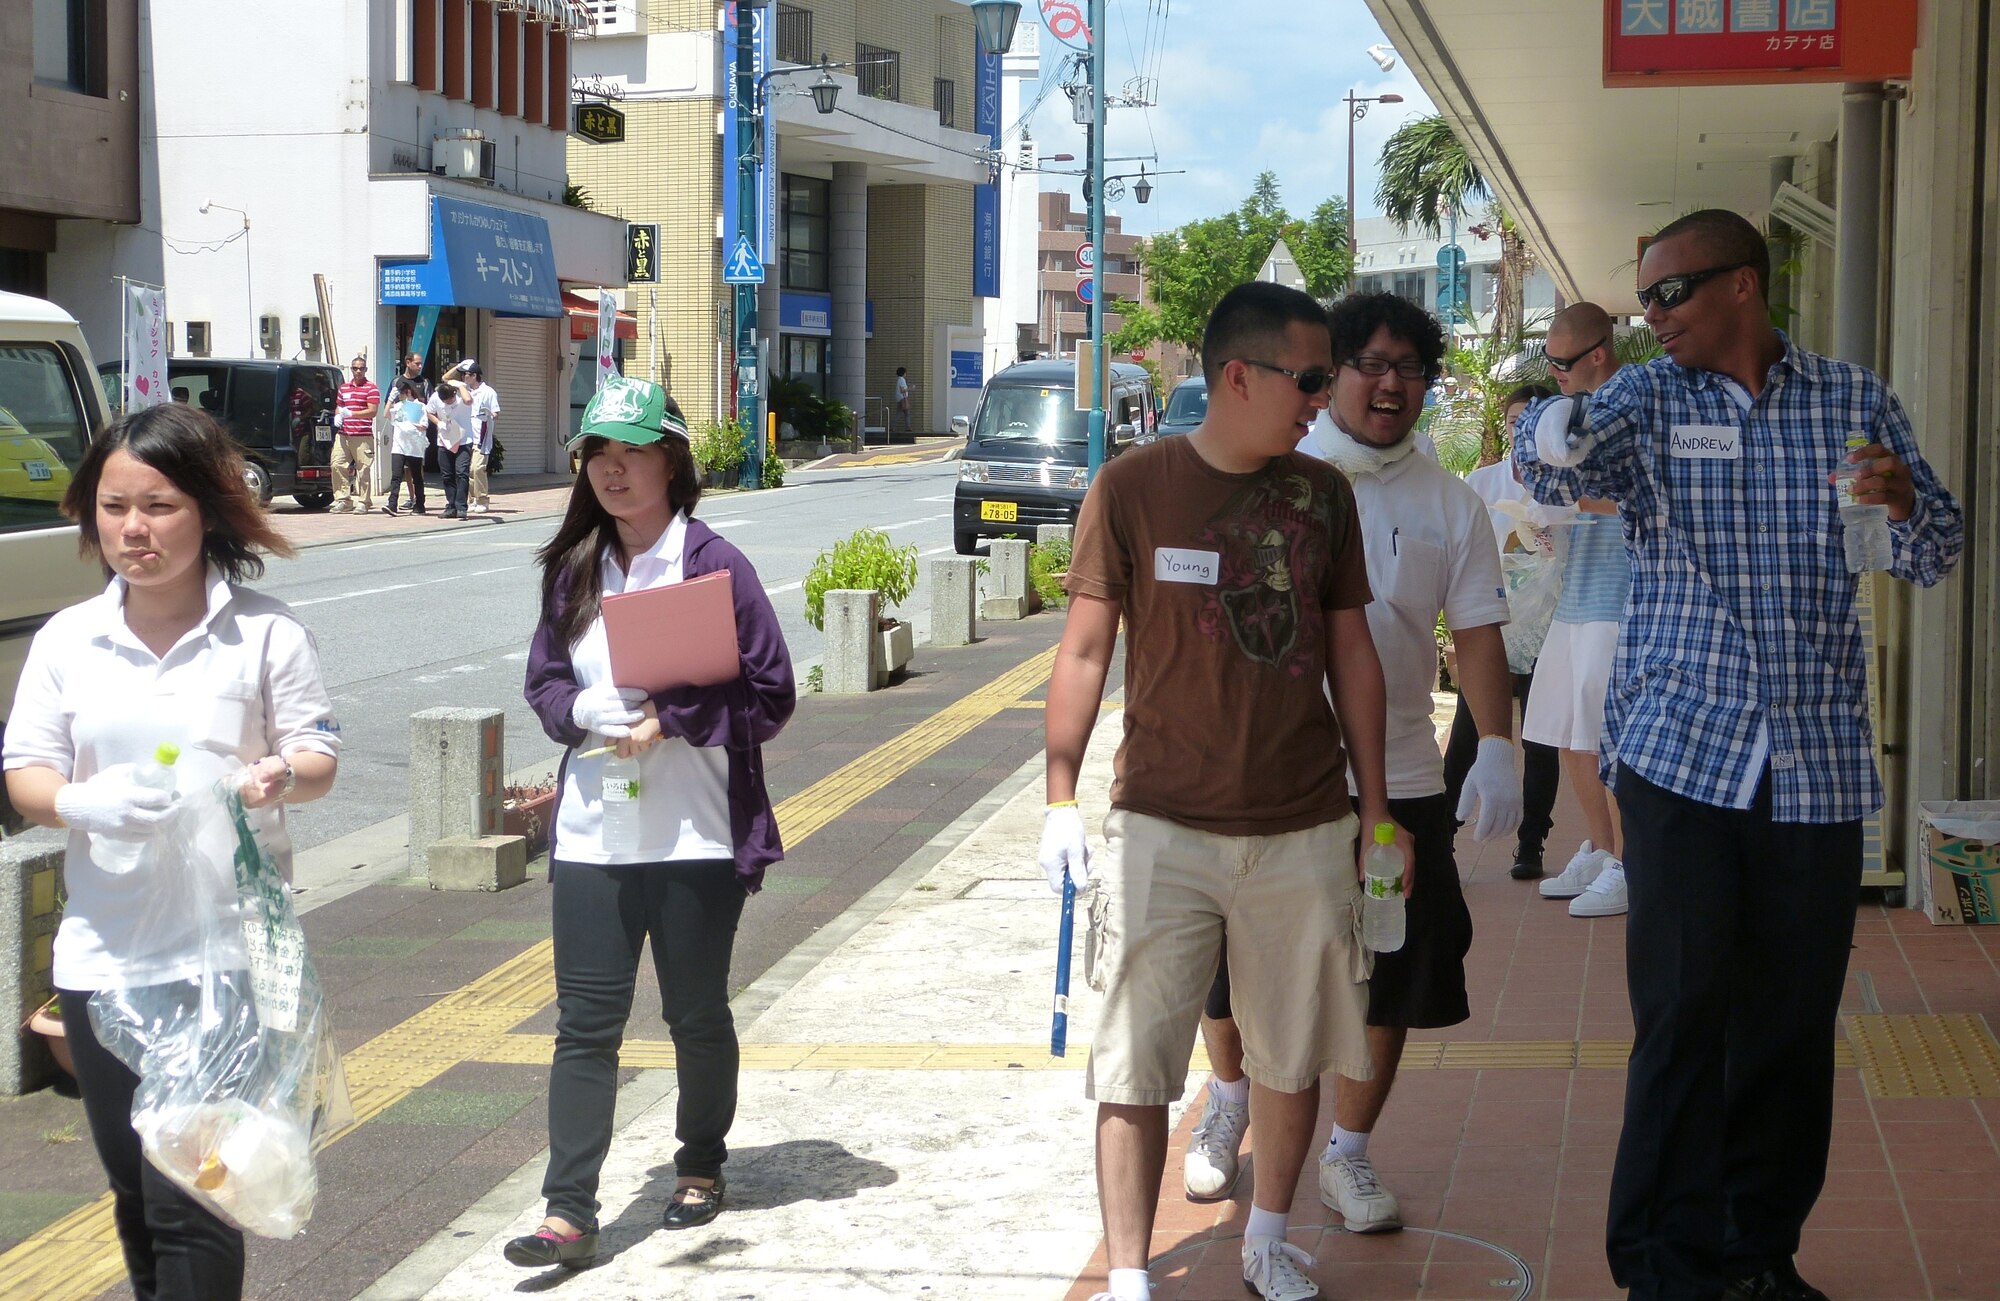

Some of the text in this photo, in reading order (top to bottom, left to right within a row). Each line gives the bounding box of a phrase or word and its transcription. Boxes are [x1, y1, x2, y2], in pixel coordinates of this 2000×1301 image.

[729, 62, 737, 109] OKINAWA
[584, 111, 617, 134] 赤と黒
[475, 252, 534, 287] キーストン
[634, 229, 650, 278] 赤と黒
[150, 297, 162, 404] ミュージック カフェ
[1670, 431, 1734, 452] ANDREW
[989, 509, 1015, 520] 78-05
[1161, 553, 1210, 579] Young
[1959, 886, 1977, 918] リボン
[1969, 871, 1992, 918] スタンダード
